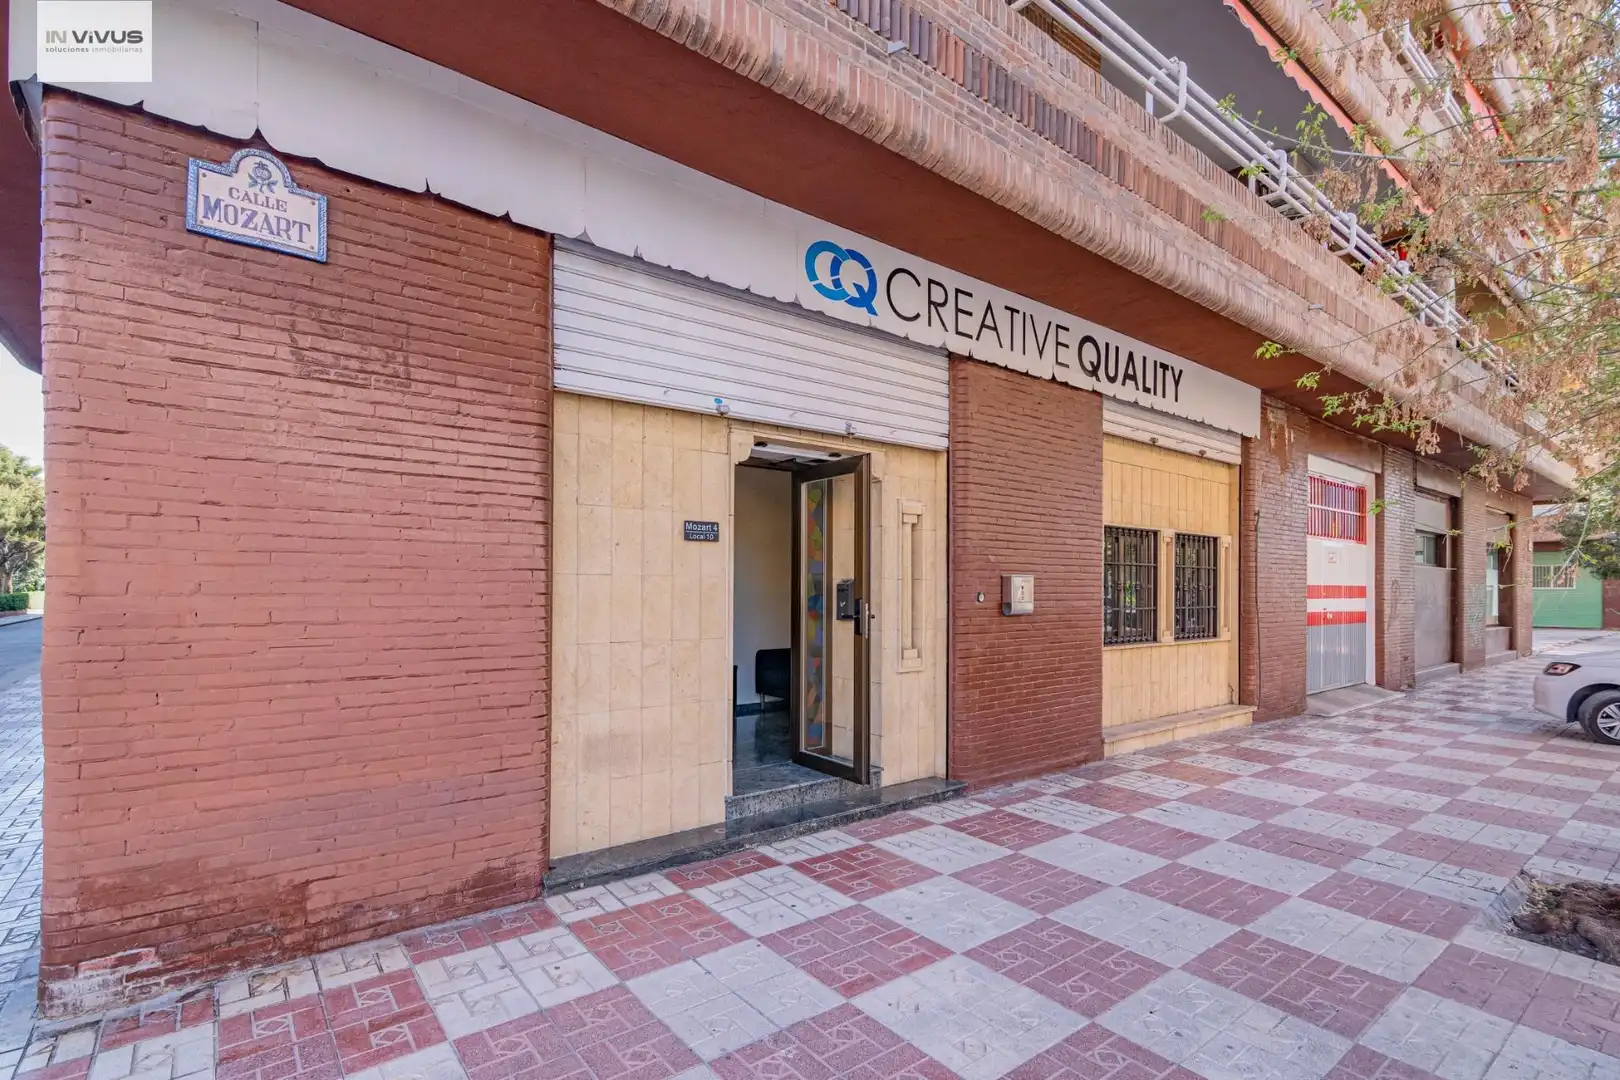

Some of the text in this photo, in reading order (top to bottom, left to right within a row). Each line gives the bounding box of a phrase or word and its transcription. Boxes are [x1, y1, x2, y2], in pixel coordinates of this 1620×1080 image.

[228, 186, 288, 213] CALLE
[201, 194, 311, 244] MOZART
[886, 267, 1184, 403] CREATIVE QUALITY
[685, 522, 718, 532] Mozart 4
